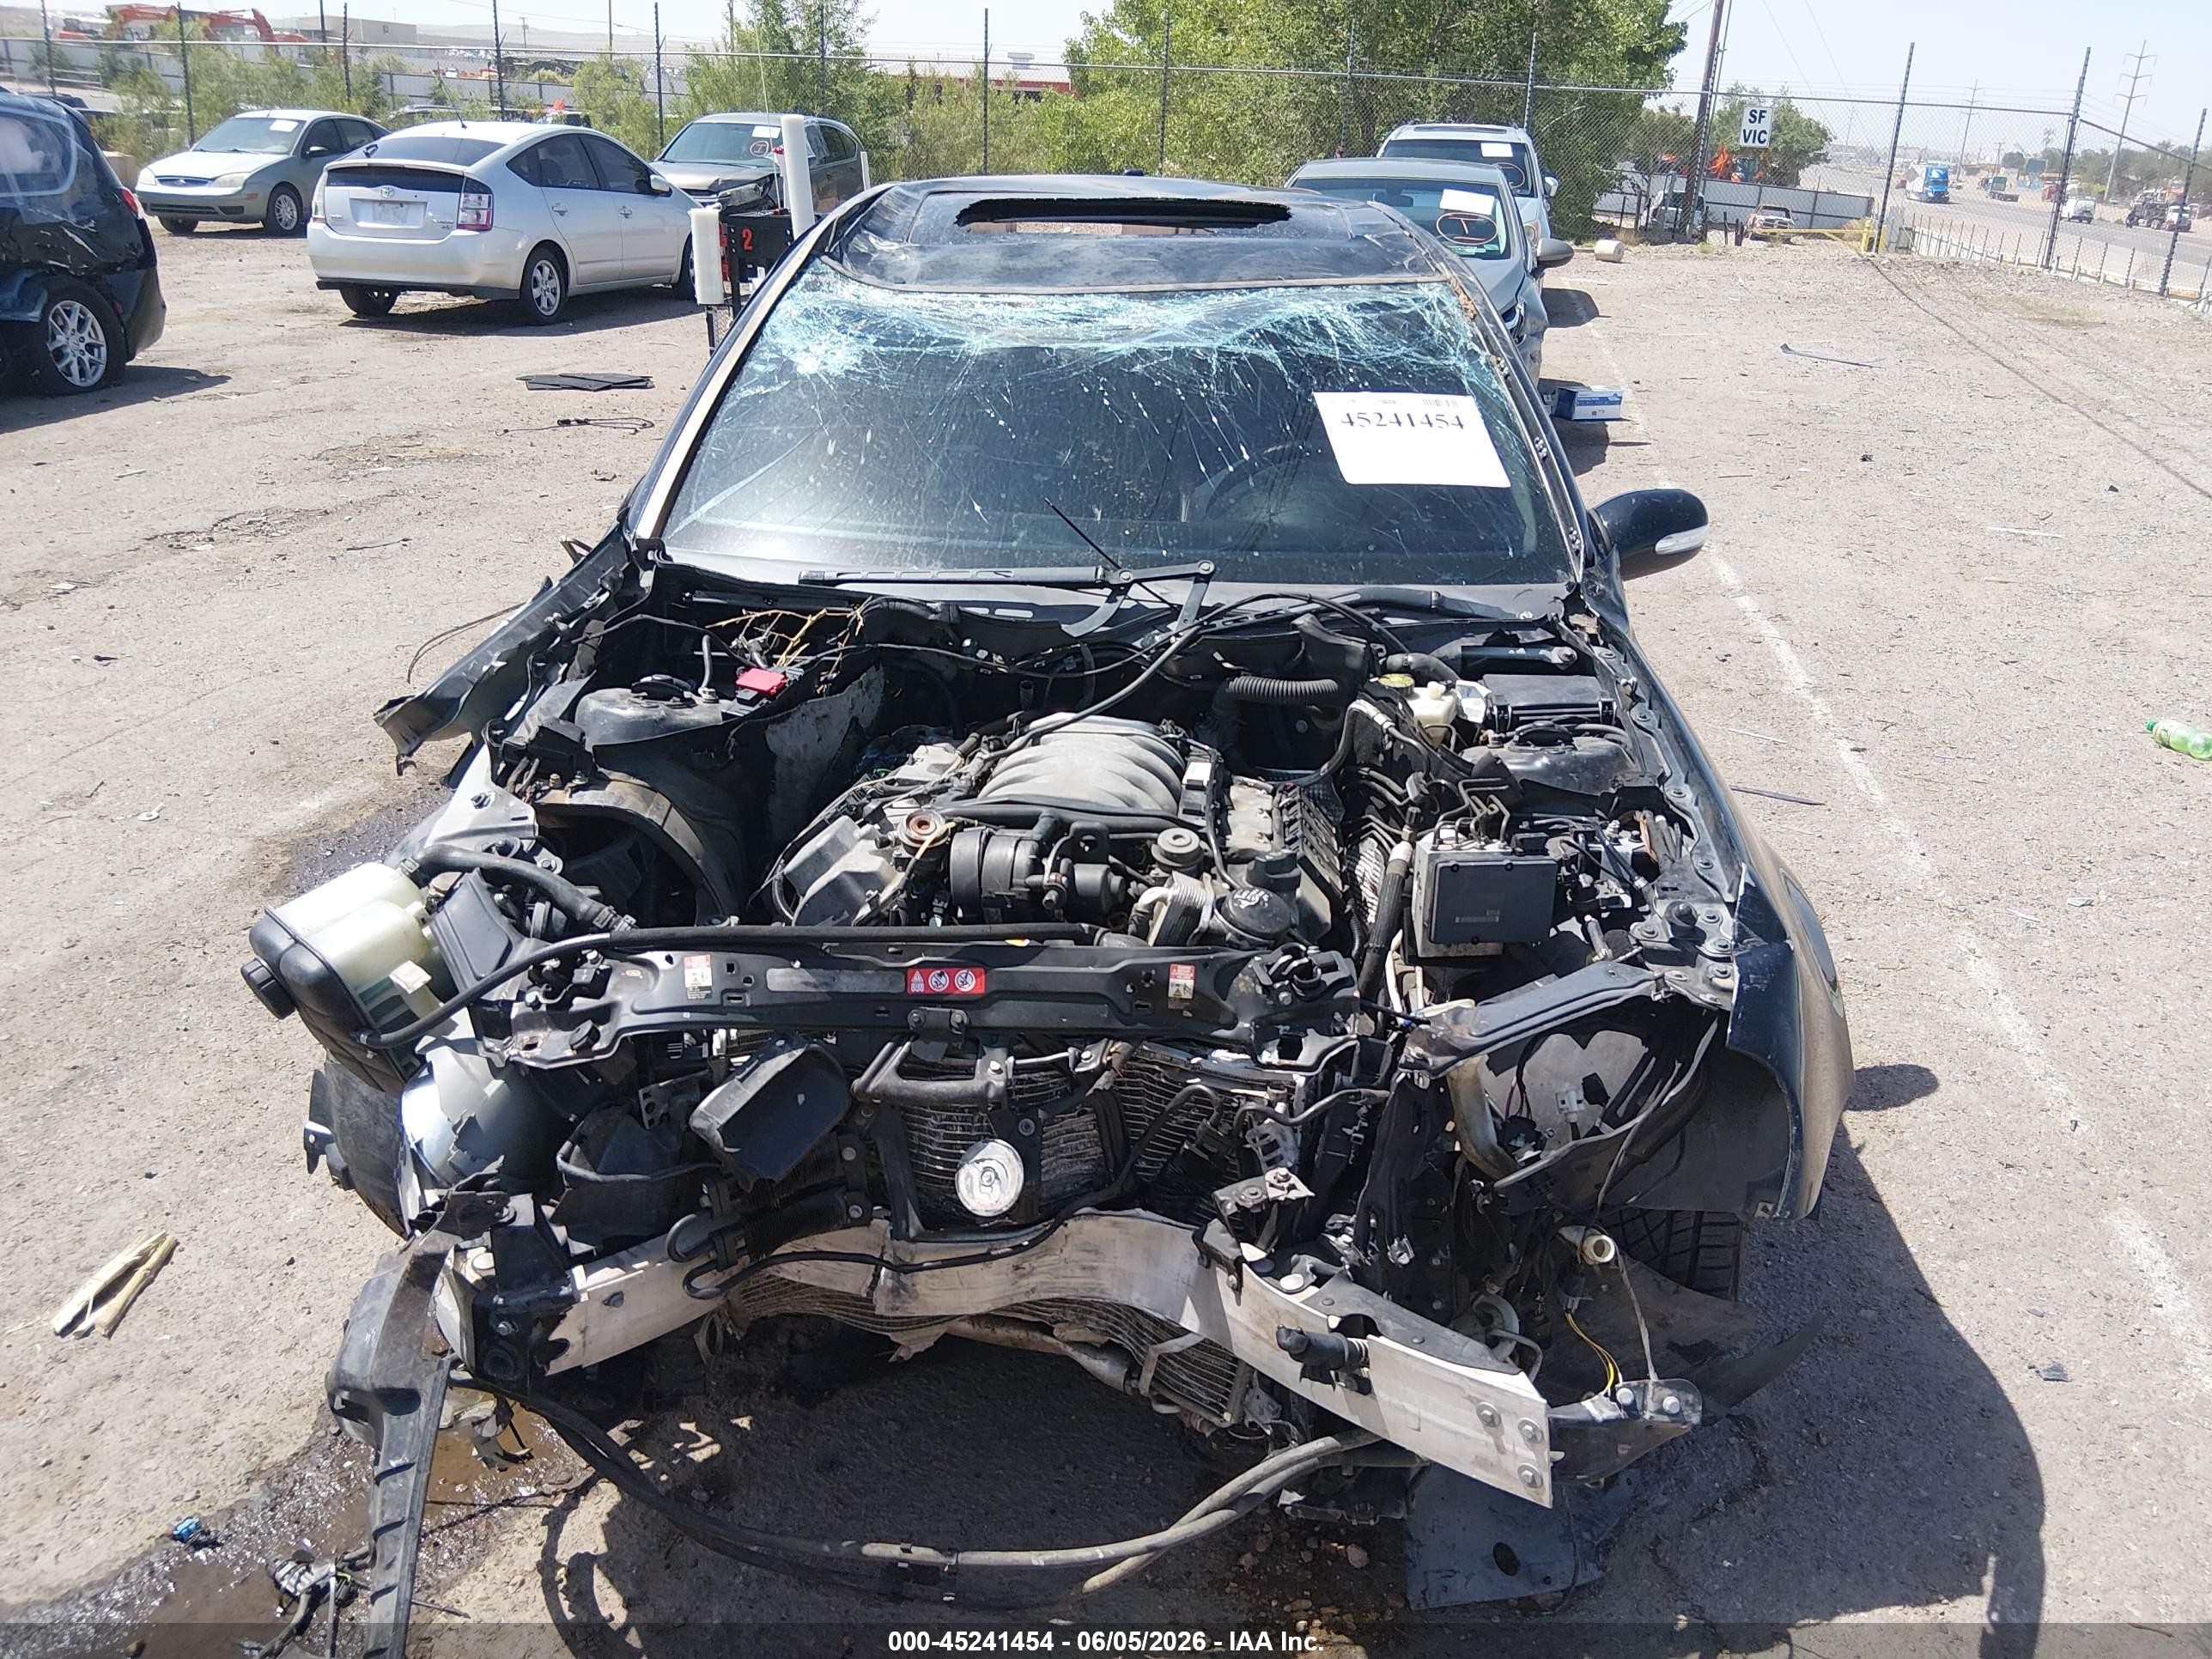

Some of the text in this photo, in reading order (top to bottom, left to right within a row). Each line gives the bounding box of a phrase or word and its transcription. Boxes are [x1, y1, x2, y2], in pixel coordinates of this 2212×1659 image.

[1748, 109, 1767, 125] SF
[1742, 129, 1767, 144] VIC
[742, 228, 753, 251] 2
[1340, 411, 1464, 429] 45241454
